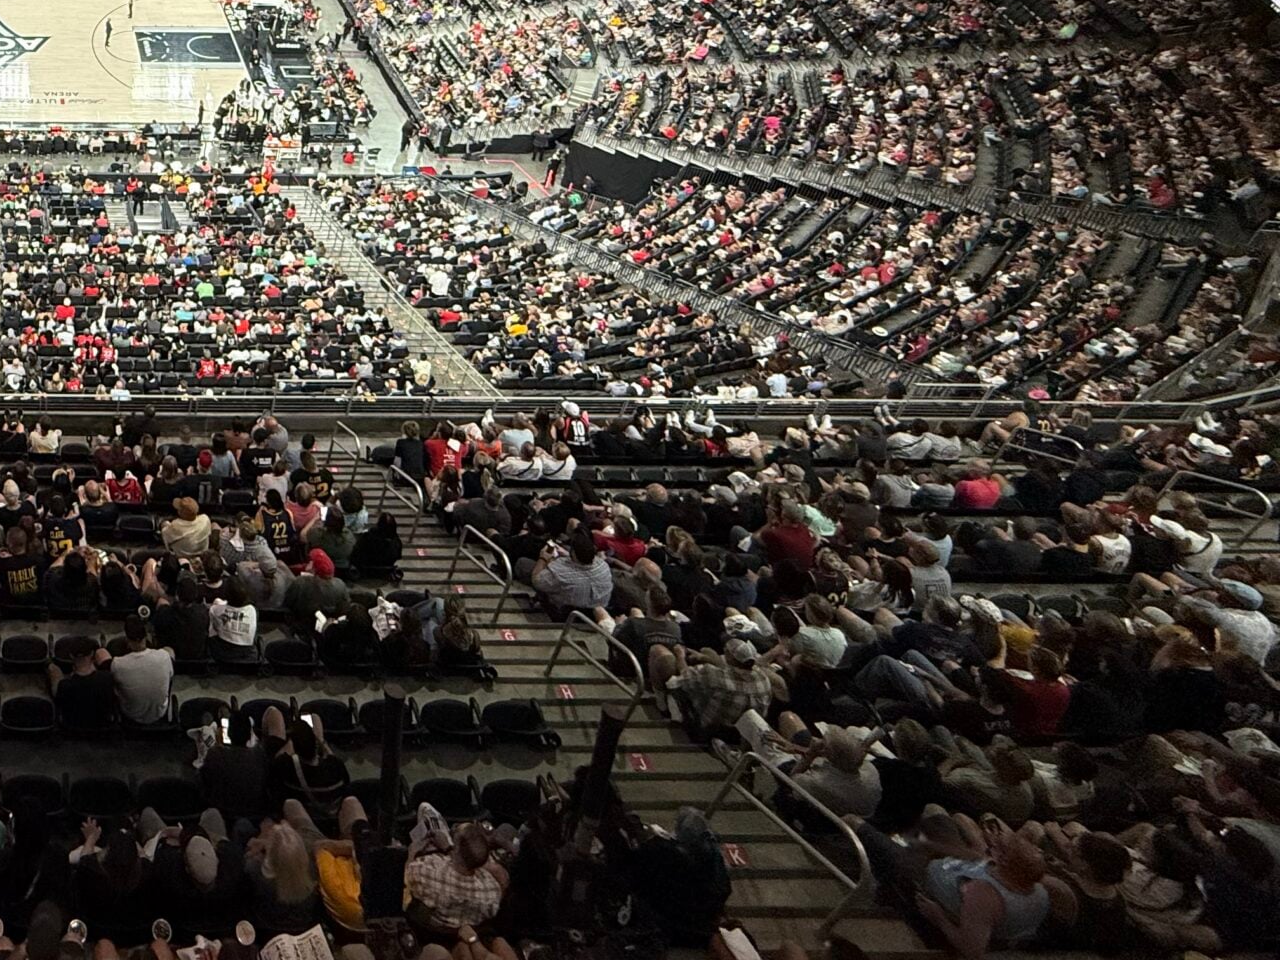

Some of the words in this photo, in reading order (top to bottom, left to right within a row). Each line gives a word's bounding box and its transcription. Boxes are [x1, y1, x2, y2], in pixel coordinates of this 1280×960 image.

[570, 420, 586, 437] 10
[271, 521, 289, 538] 22
[505, 631, 515, 640] G
[563, 686, 574, 698] H
[639, 757, 648, 771] J
[731, 849, 746, 865] K
